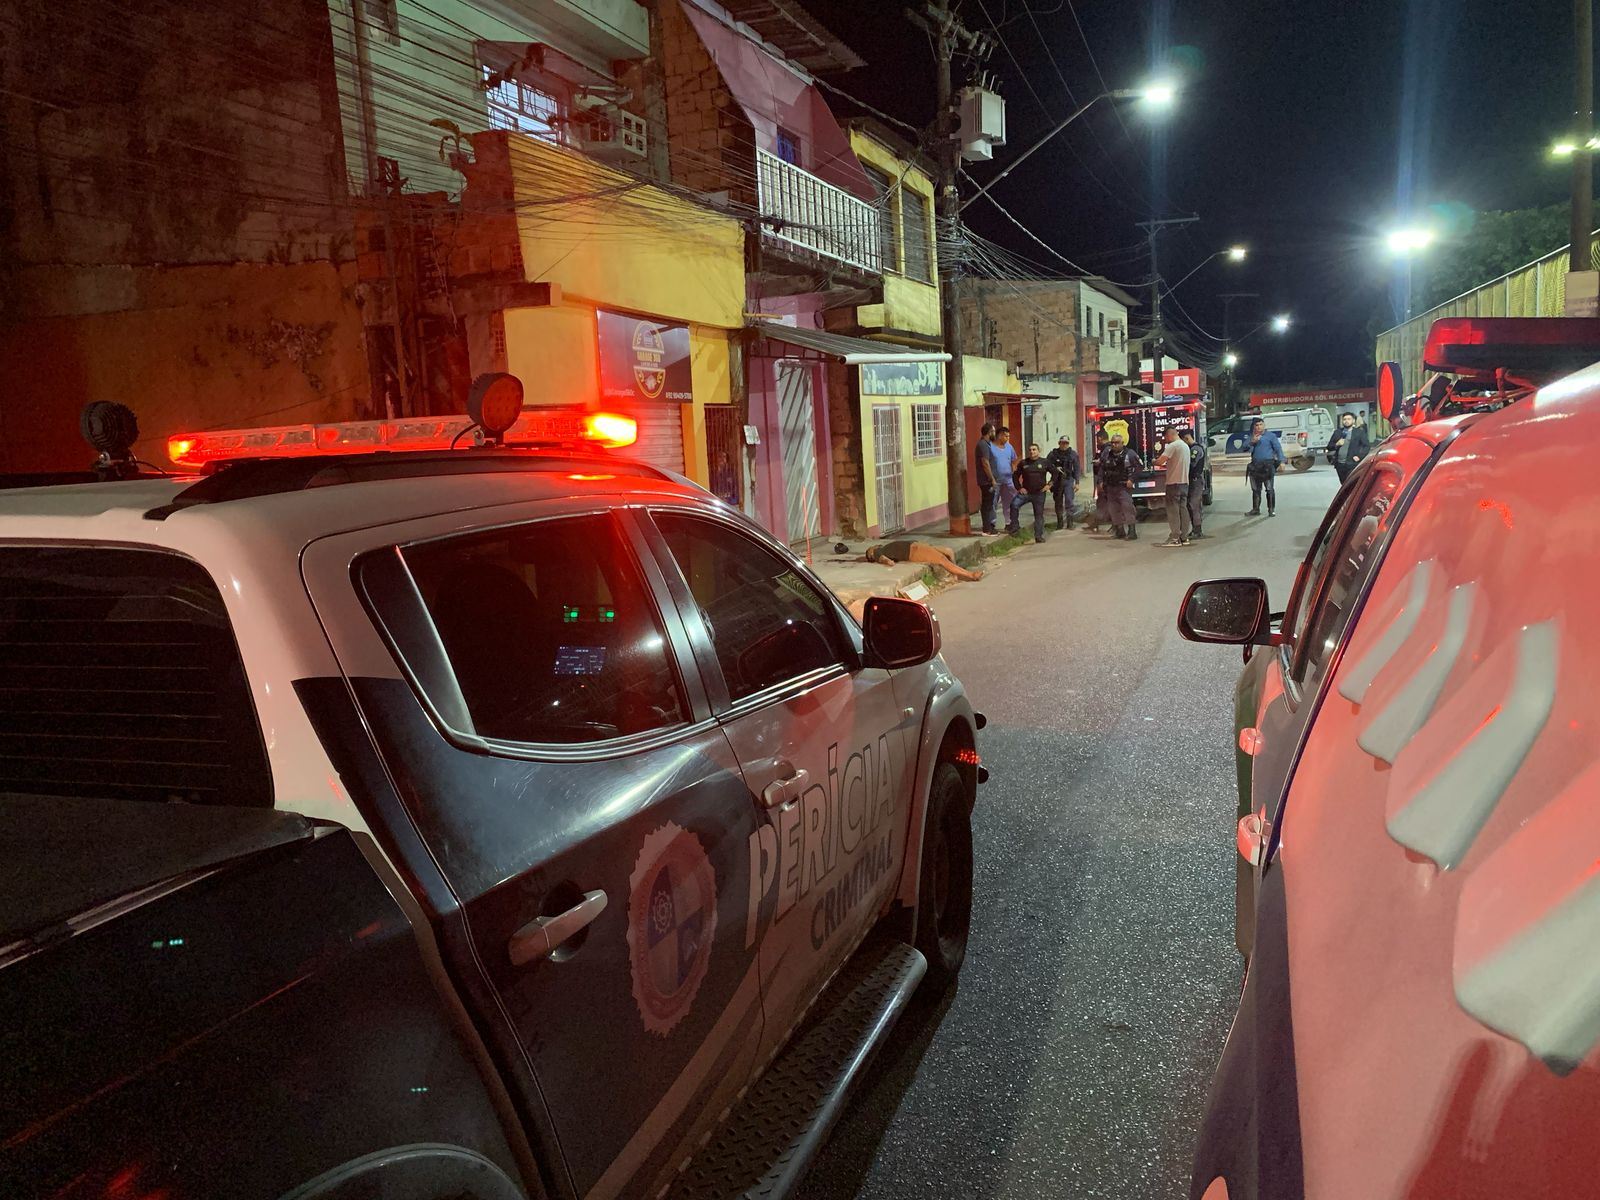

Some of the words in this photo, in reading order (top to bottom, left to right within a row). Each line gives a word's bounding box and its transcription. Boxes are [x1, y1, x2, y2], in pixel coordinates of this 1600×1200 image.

[1262, 395, 1314, 404] DISTRIBUIDORA
[1328, 391, 1364, 400] NASCENTE
[1155, 416, 1190, 426] IML-DPTC
[810, 828, 894, 951] CRIMINAL
